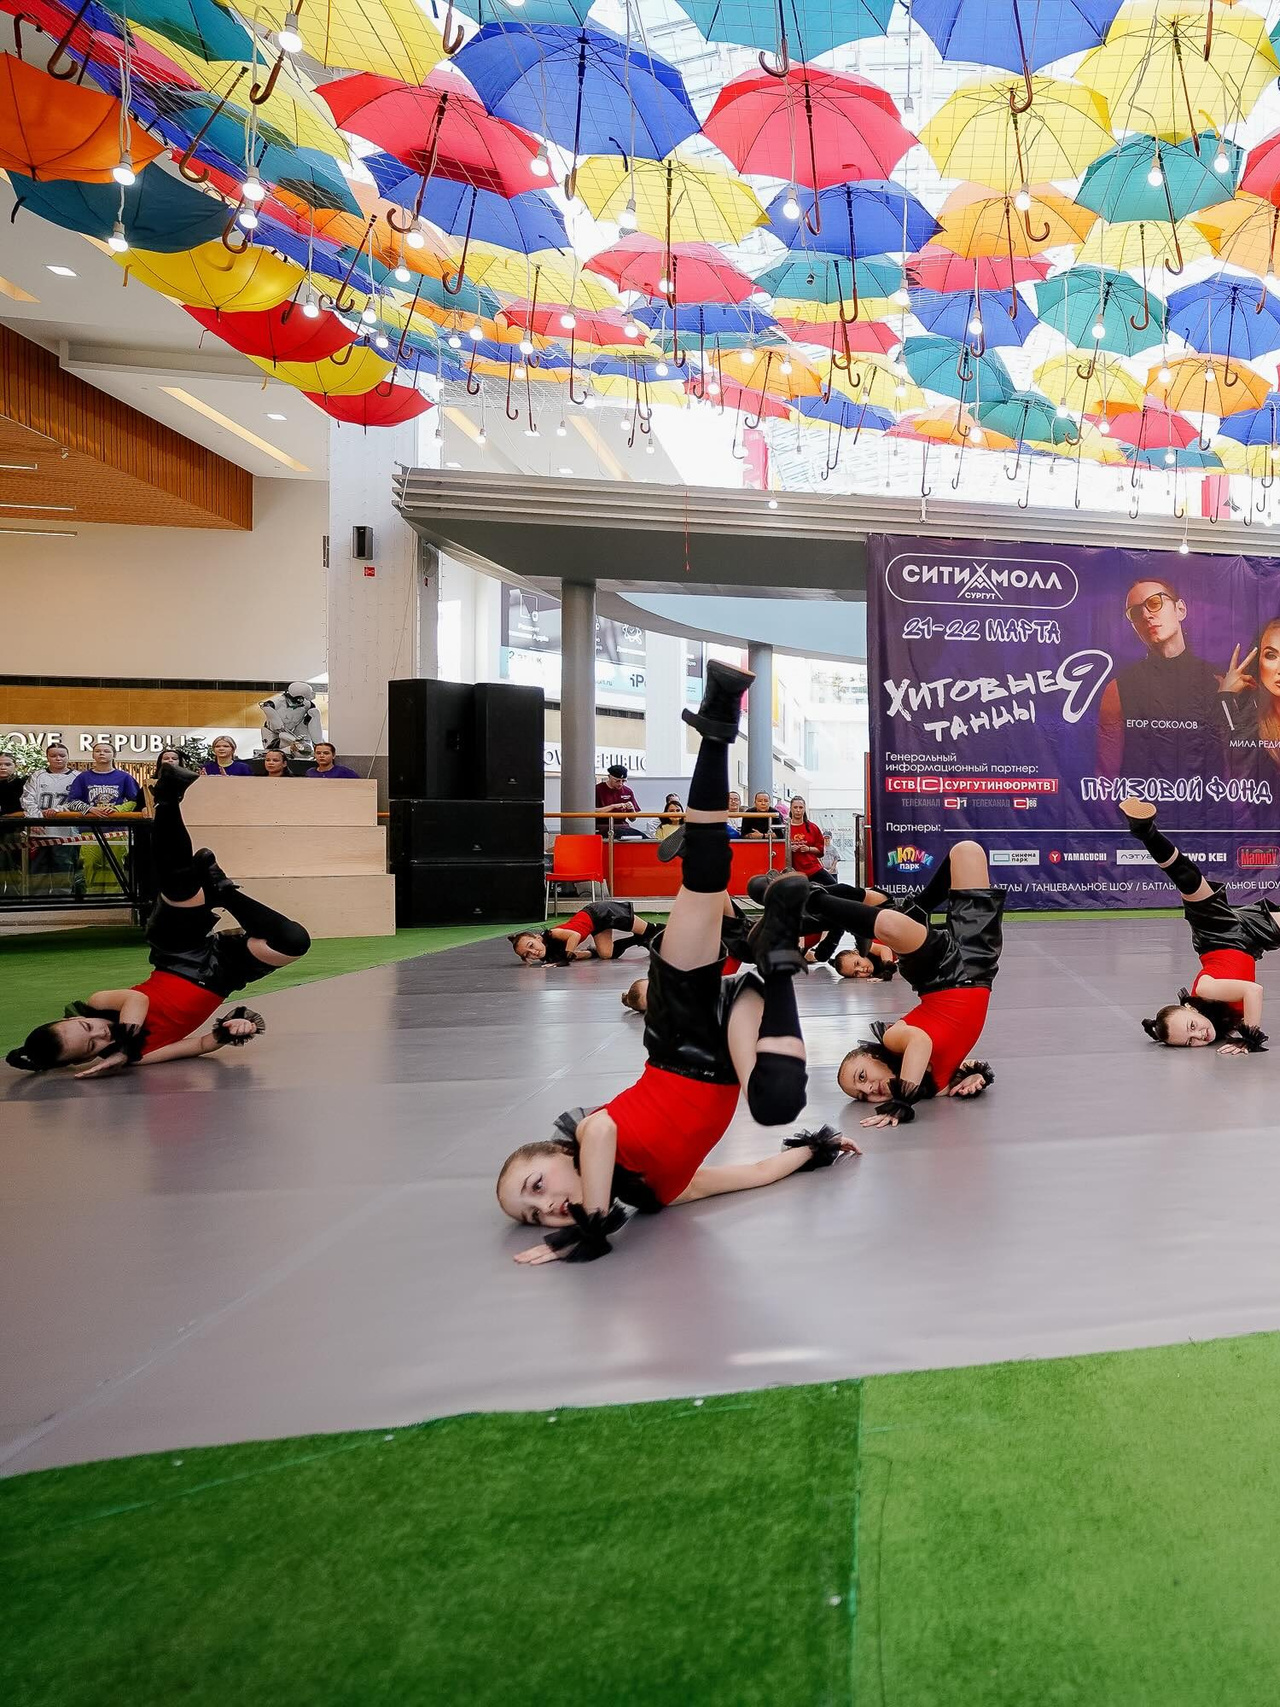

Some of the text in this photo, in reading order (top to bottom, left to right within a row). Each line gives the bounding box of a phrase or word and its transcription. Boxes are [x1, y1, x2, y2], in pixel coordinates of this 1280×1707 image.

[902, 565, 1063, 589] СИТИ МОЛЛ
[965, 592, 996, 600] СУРГУТ
[902, 617, 1061, 644] 21-22 МАРТА
[923, 700, 1036, 742] ТАНЦЫ
[1126, 720, 1198, 729] ЕГОР СОКОЛОВ
[80, 733, 206, 753] REPUBLI
[1229, 740, 1257, 748] МИЛА
[596, 753, 647, 771] EPUBLIC
[885, 752, 957, 764] Генеральный
[885, 762, 1039, 774] информационный партнер:
[1081, 775, 1272, 804] ПРИЗОВОЙ ФОНД
[886, 823, 941, 833] Партнеры:
[1063, 853, 1107, 861] YAMAGUCHI
[1208, 853, 1227, 861] KEI
[989, 883, 1022, 892] АТТЛЫ
[1032, 882, 1107, 893] ТАНЦЕВАЛЬНОЕ
[1109, 882, 1133, 892] ШОУ
[1142, 882, 1177, 891] БАТТЛЫ
[1258, 881, 1280, 889] ШОУ
